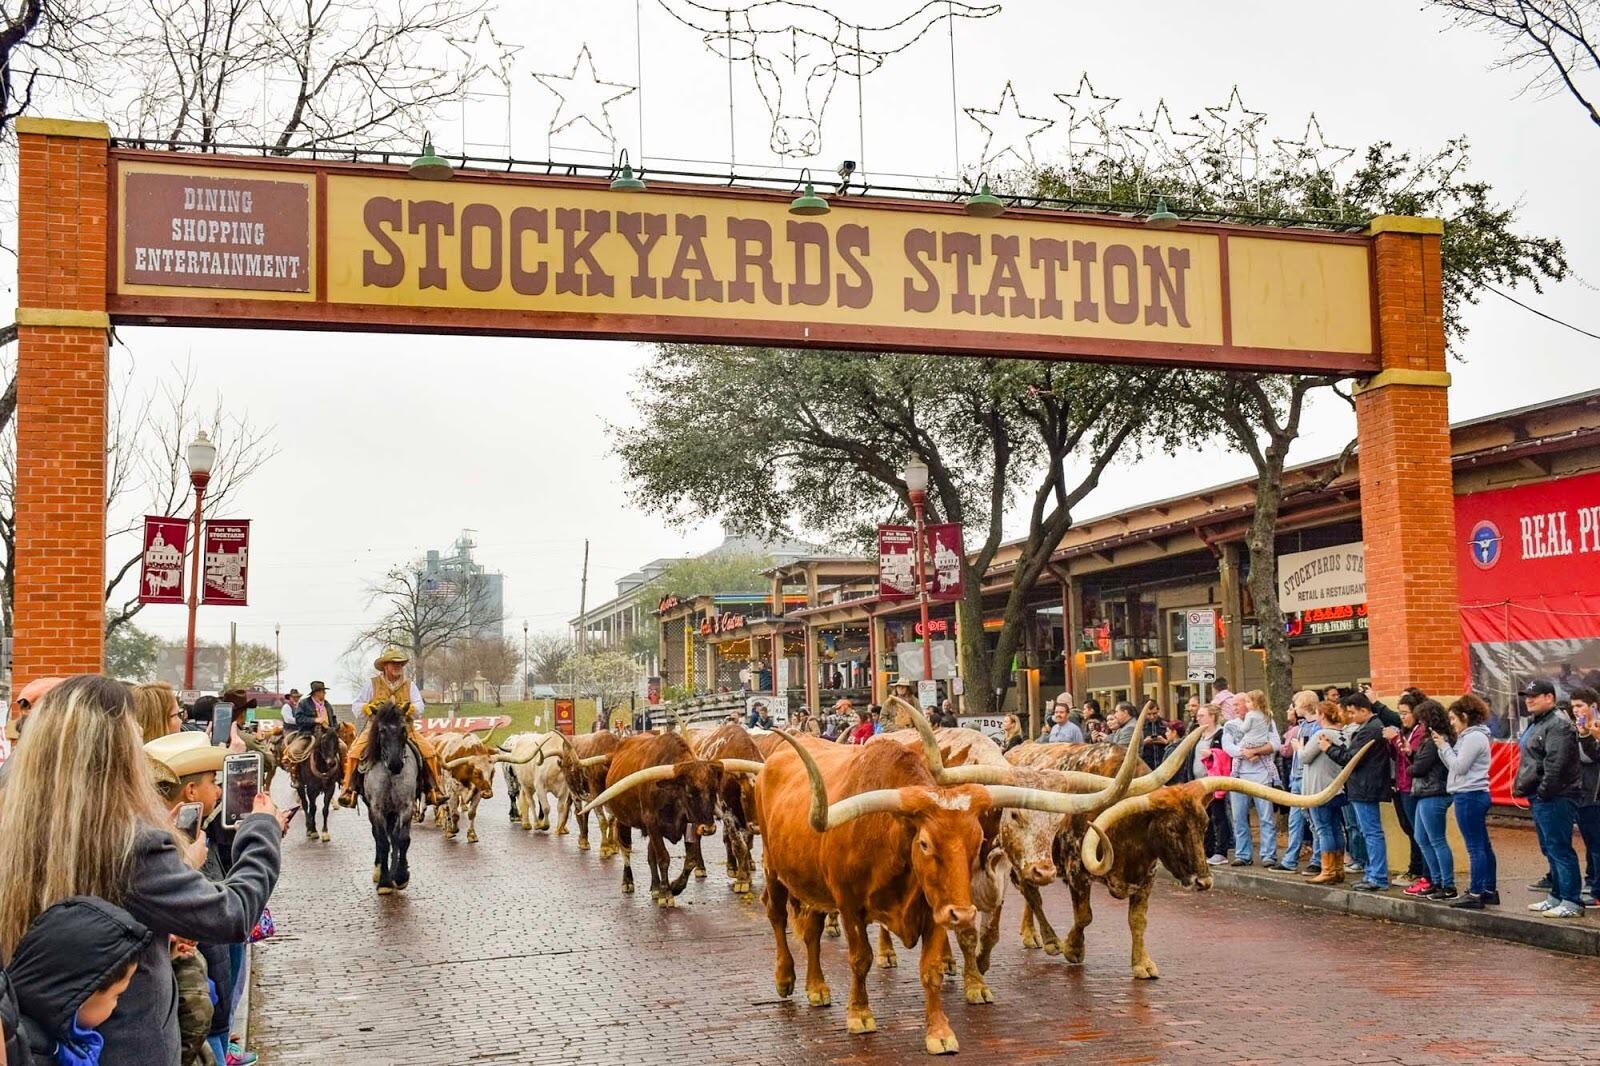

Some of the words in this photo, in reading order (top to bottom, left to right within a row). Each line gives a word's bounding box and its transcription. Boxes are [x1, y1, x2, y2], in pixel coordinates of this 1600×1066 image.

[184, 187, 253, 214] DINING
[171, 217, 265, 246] SHOPPING
[134, 247, 300, 279] ENTERTAINMENT
[363, 196, 873, 310] STOCKYARDS
[903, 227, 1191, 329] STATION
[1520, 511, 1573, 560] REAL
[1577, 505, 1600, 553] PI
[1283, 553, 1341, 596] STOCKYARDS
[1297, 590, 1319, 602] RETAIL
[1320, 588, 1325, 599] &
[1326, 582, 1367, 598] RESTAURANT
[1309, 619, 1353, 635] TRADING
[413, 716, 501, 731] SWIFT
[961, 719, 1003, 729] CBOY
